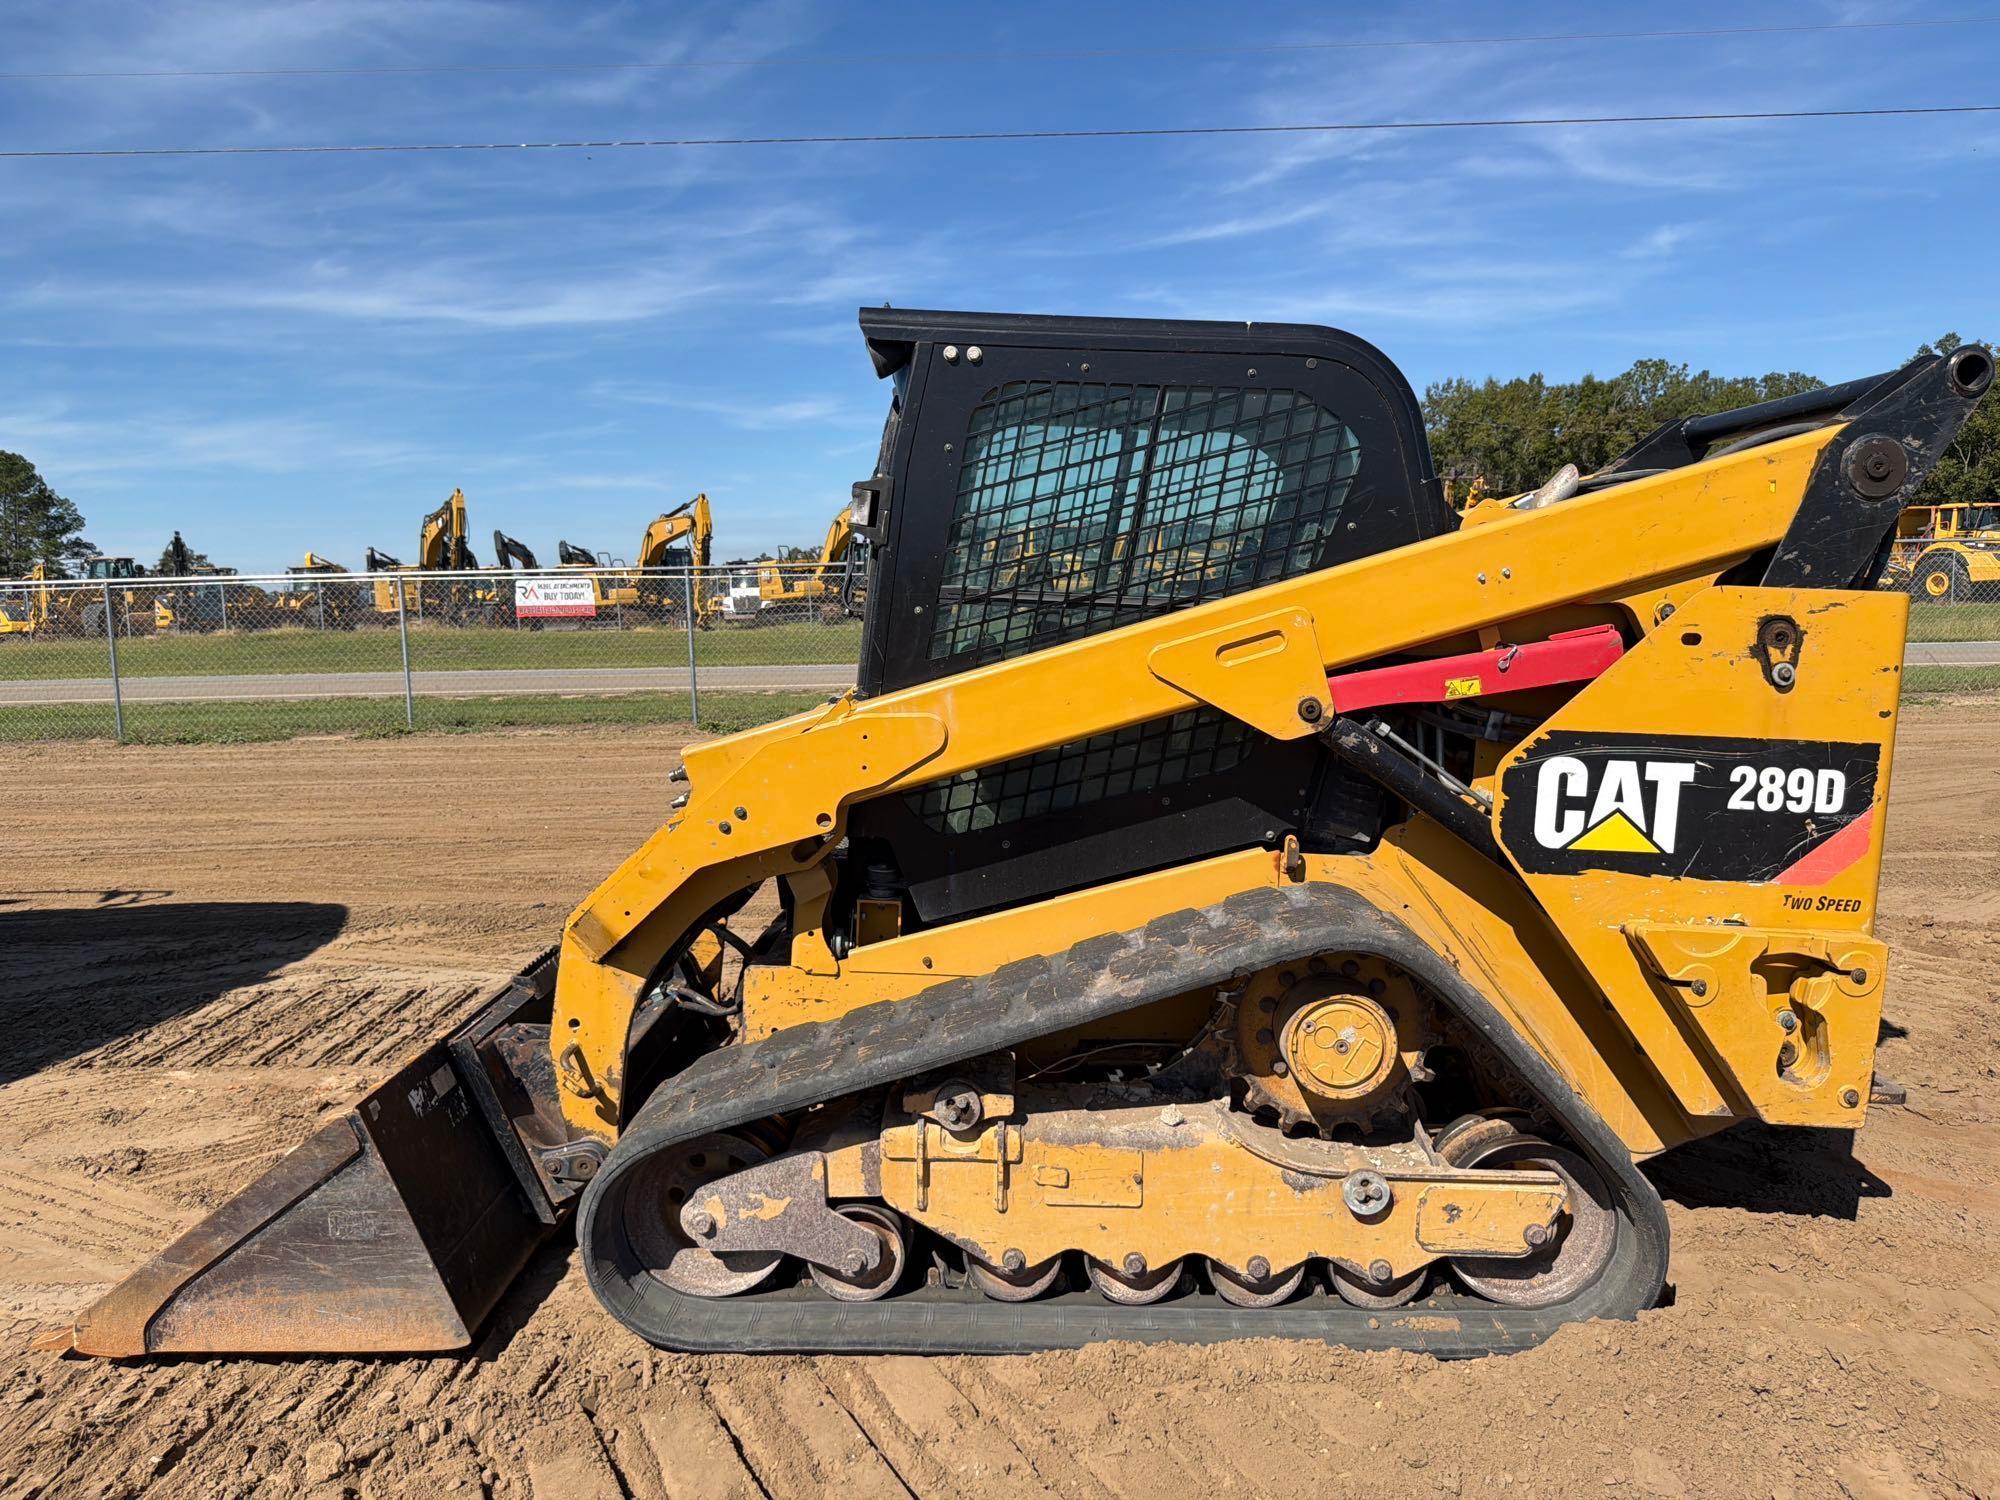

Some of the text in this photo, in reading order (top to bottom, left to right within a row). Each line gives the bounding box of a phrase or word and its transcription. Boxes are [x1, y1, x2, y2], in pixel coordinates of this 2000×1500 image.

[544, 592, 558, 600] BUY
[1534, 756, 1696, 854] CAT
[1727, 765, 1846, 814] 289D
[1783, 895, 1862, 912] TWO SPEED
